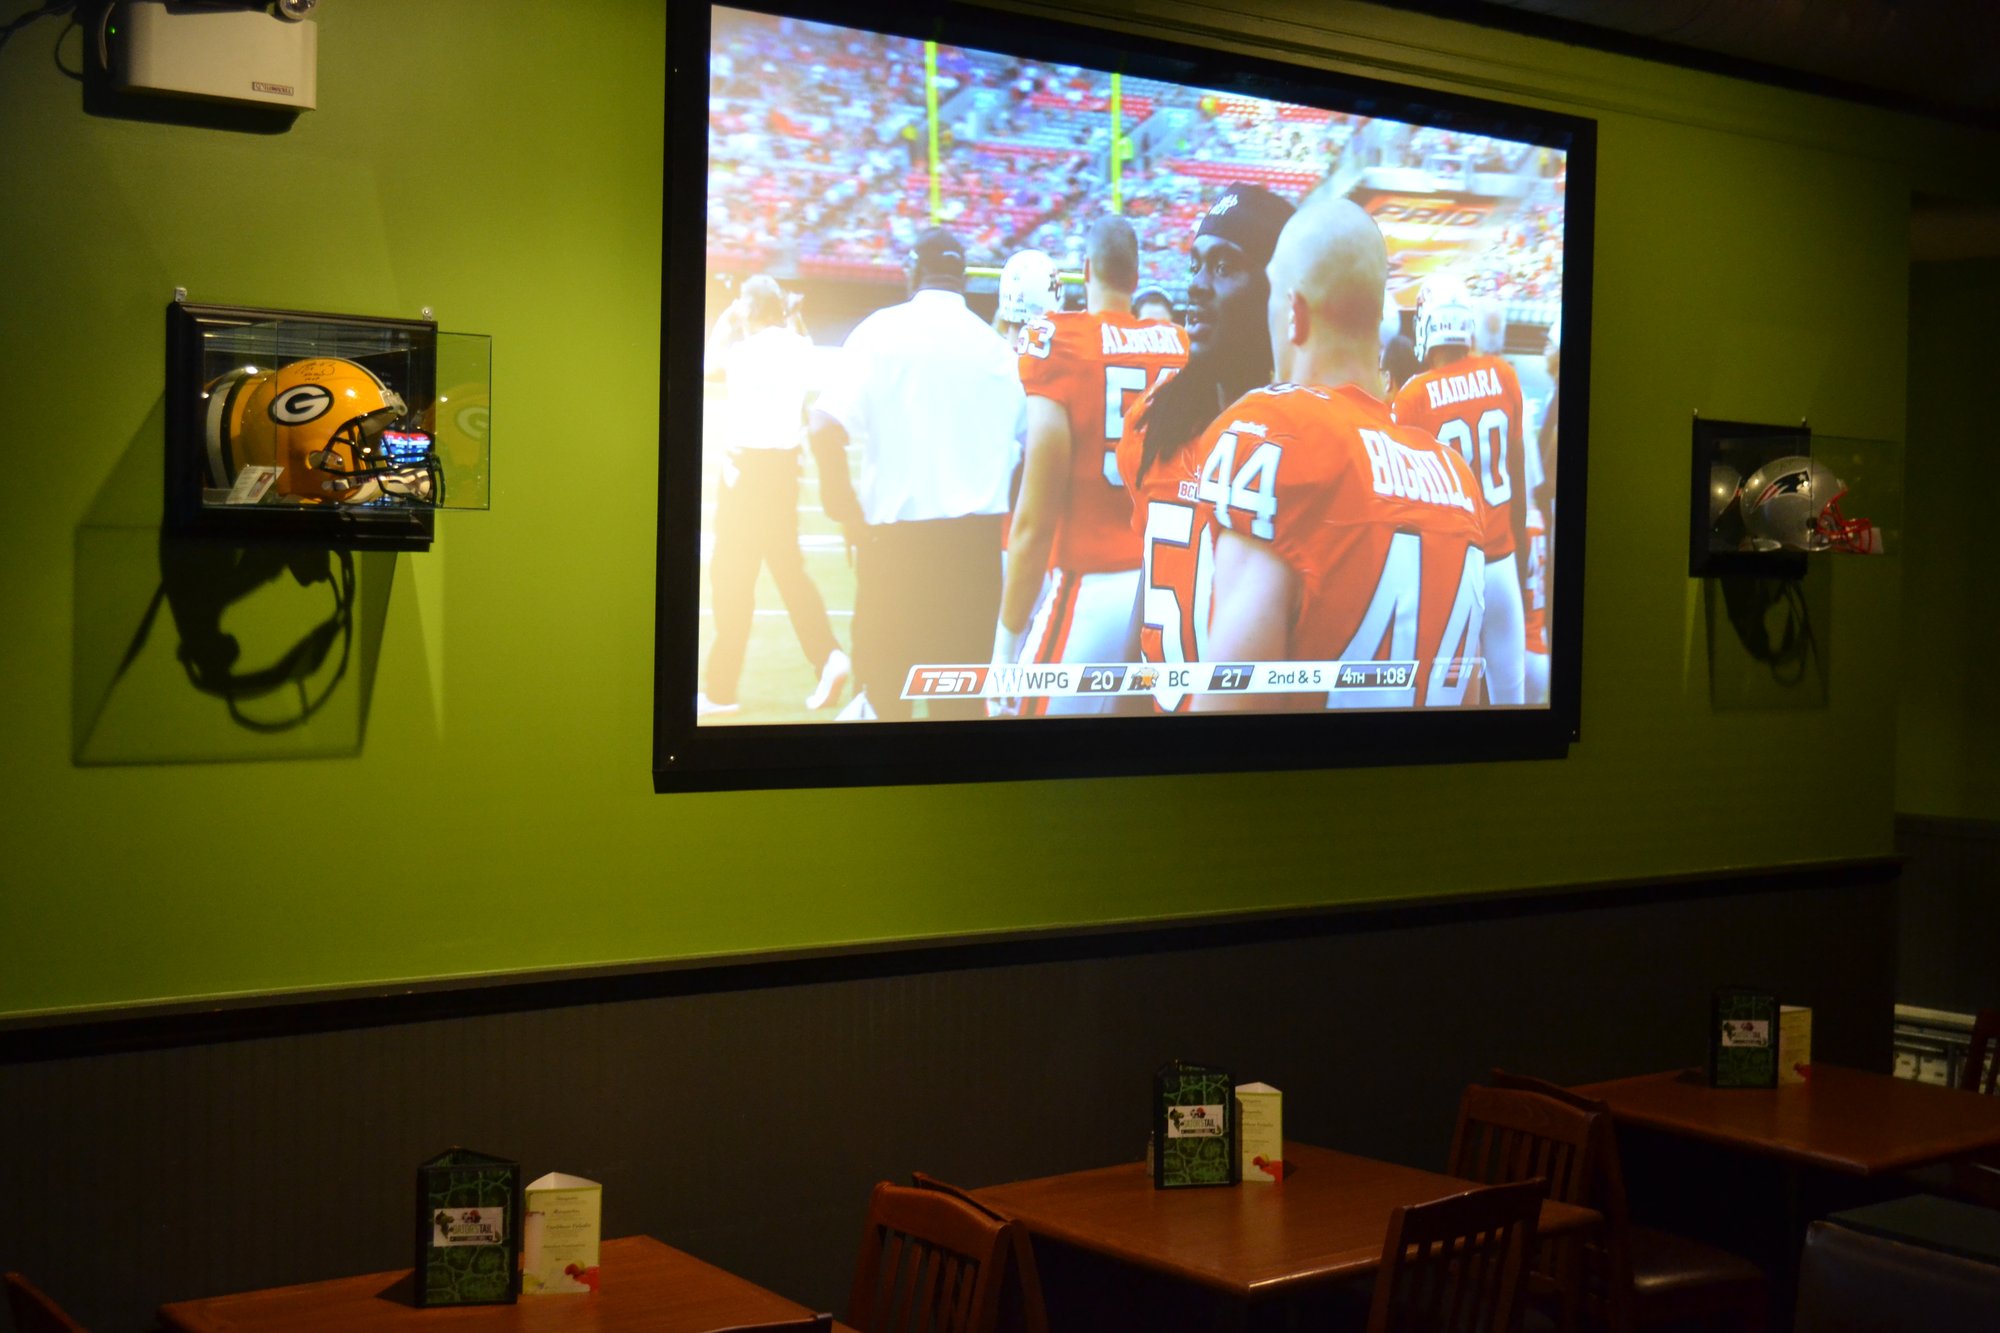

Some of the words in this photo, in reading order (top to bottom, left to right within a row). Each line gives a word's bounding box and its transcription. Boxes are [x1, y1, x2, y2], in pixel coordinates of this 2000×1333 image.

[270, 385, 332, 424] G
[1426, 367, 1502, 409] HAIDARA
[1200, 431, 1283, 542] 44
[1358, 428, 1475, 513] BIGHILL
[1325, 531, 1486, 708] 44
[919, 670, 978, 693] TSN
[1026, 671, 1069, 690] WPG
[1090, 670, 1115, 690] 20
[1168, 670, 1190, 687] BC
[1221, 668, 1243, 688] 27
[1267, 669, 1295, 685] 2nd
[1297, 669, 1310, 685] &
[1312, 669, 1322, 685] 5
[1341, 668, 1366, 685] 4TH
[1374, 667, 1407, 685] 1:08
